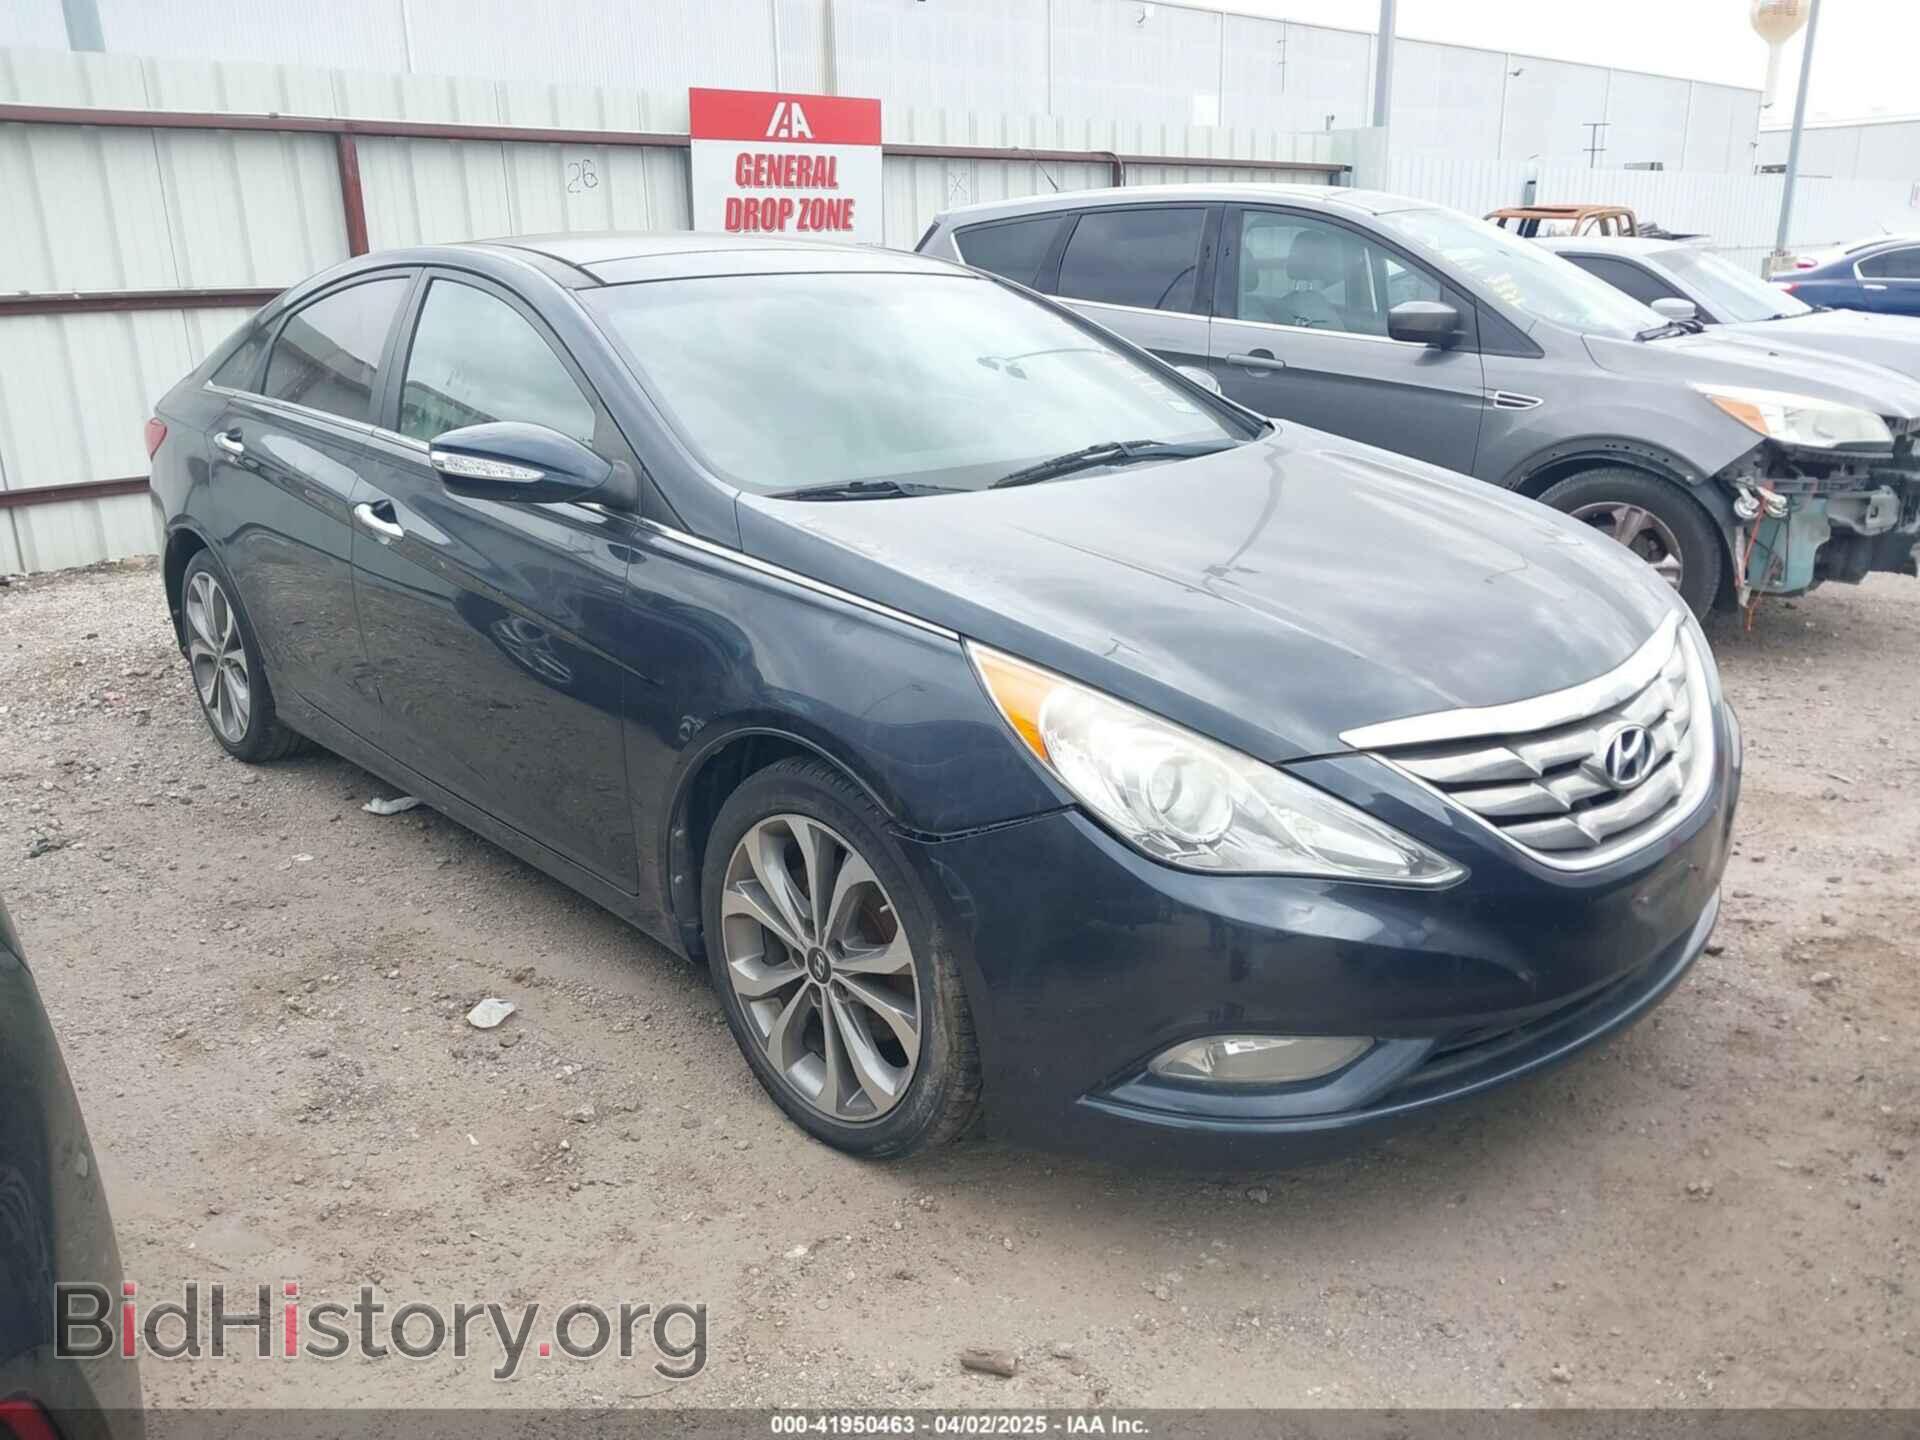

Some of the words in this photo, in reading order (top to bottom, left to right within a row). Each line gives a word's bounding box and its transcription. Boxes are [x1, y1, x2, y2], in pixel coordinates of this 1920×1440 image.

[735, 153, 839, 189] GENERAL
[724, 198, 794, 232] DROP
[796, 198, 855, 232] ZONE
